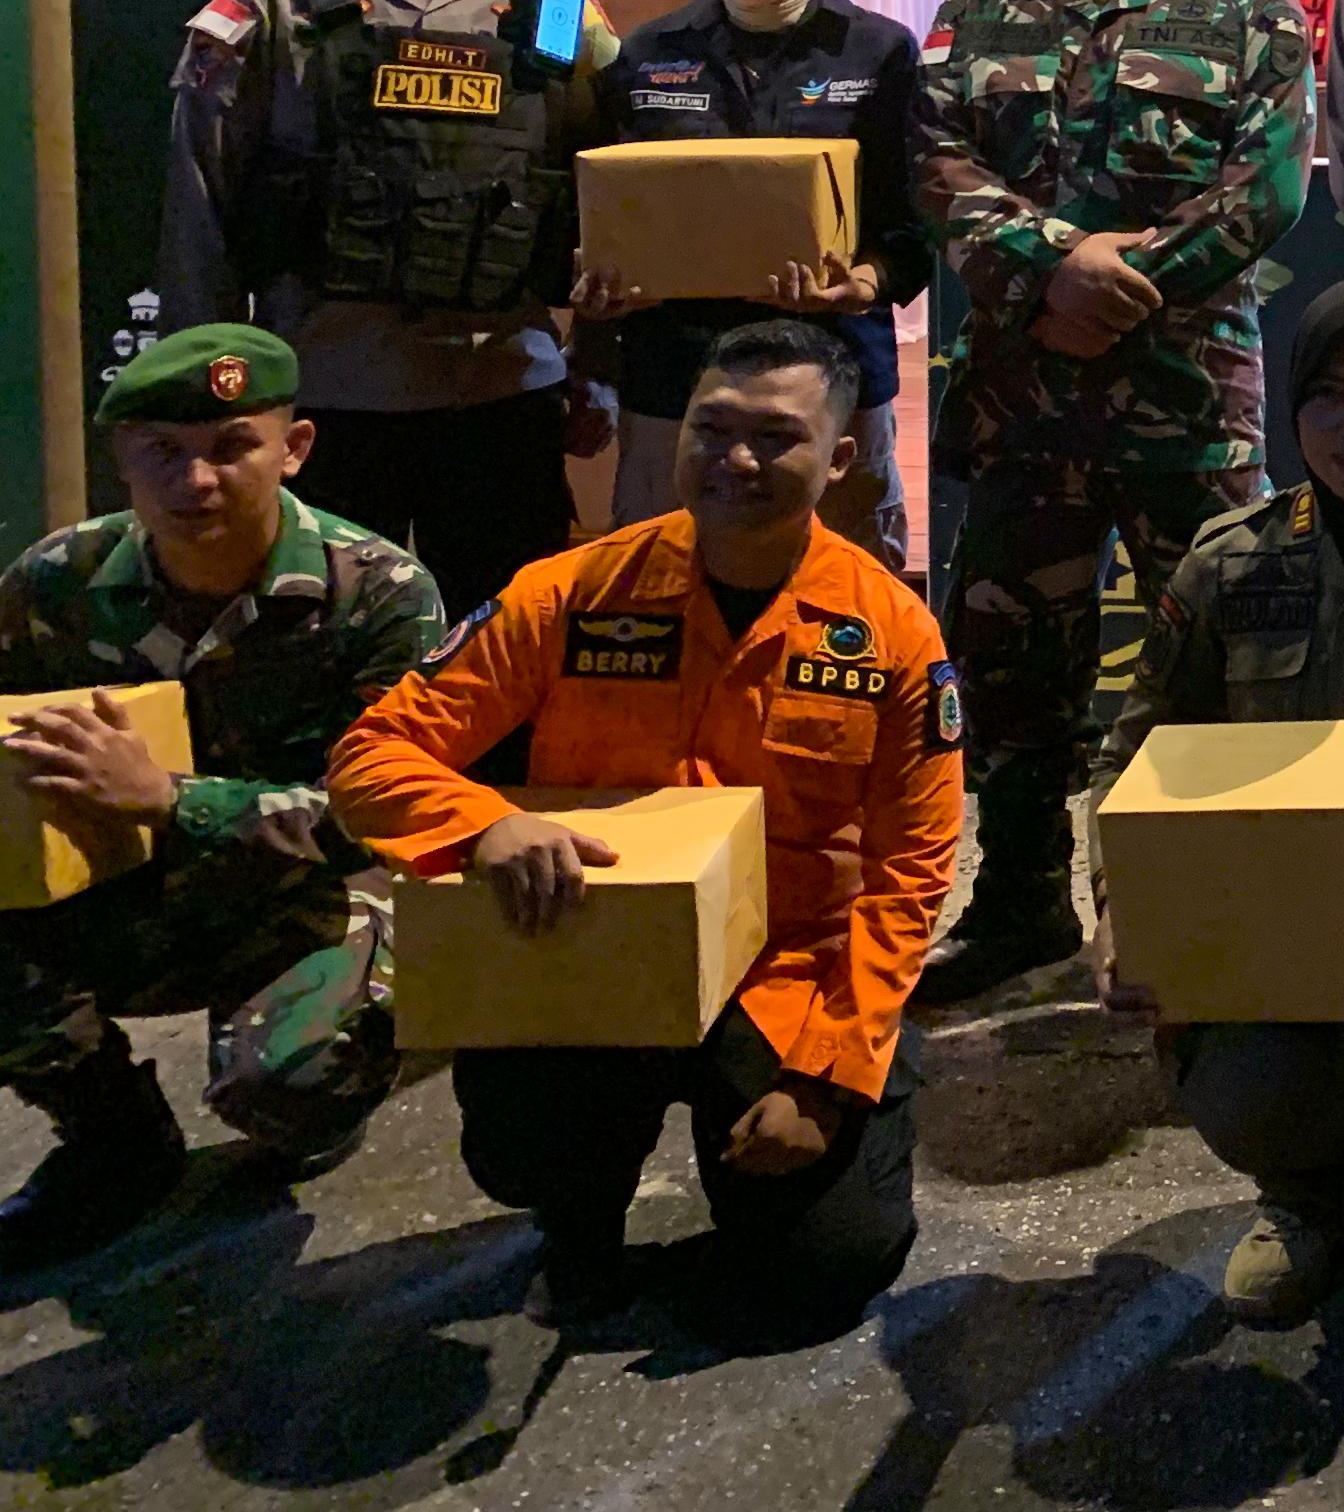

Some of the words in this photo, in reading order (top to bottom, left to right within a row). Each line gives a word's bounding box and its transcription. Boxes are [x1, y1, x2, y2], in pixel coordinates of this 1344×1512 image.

[1137, 27, 1179, 42] TNI
[382, 71, 497, 110] POLISI
[576, 650, 669, 676] BERRY
[796, 662, 887, 694] BPBD
